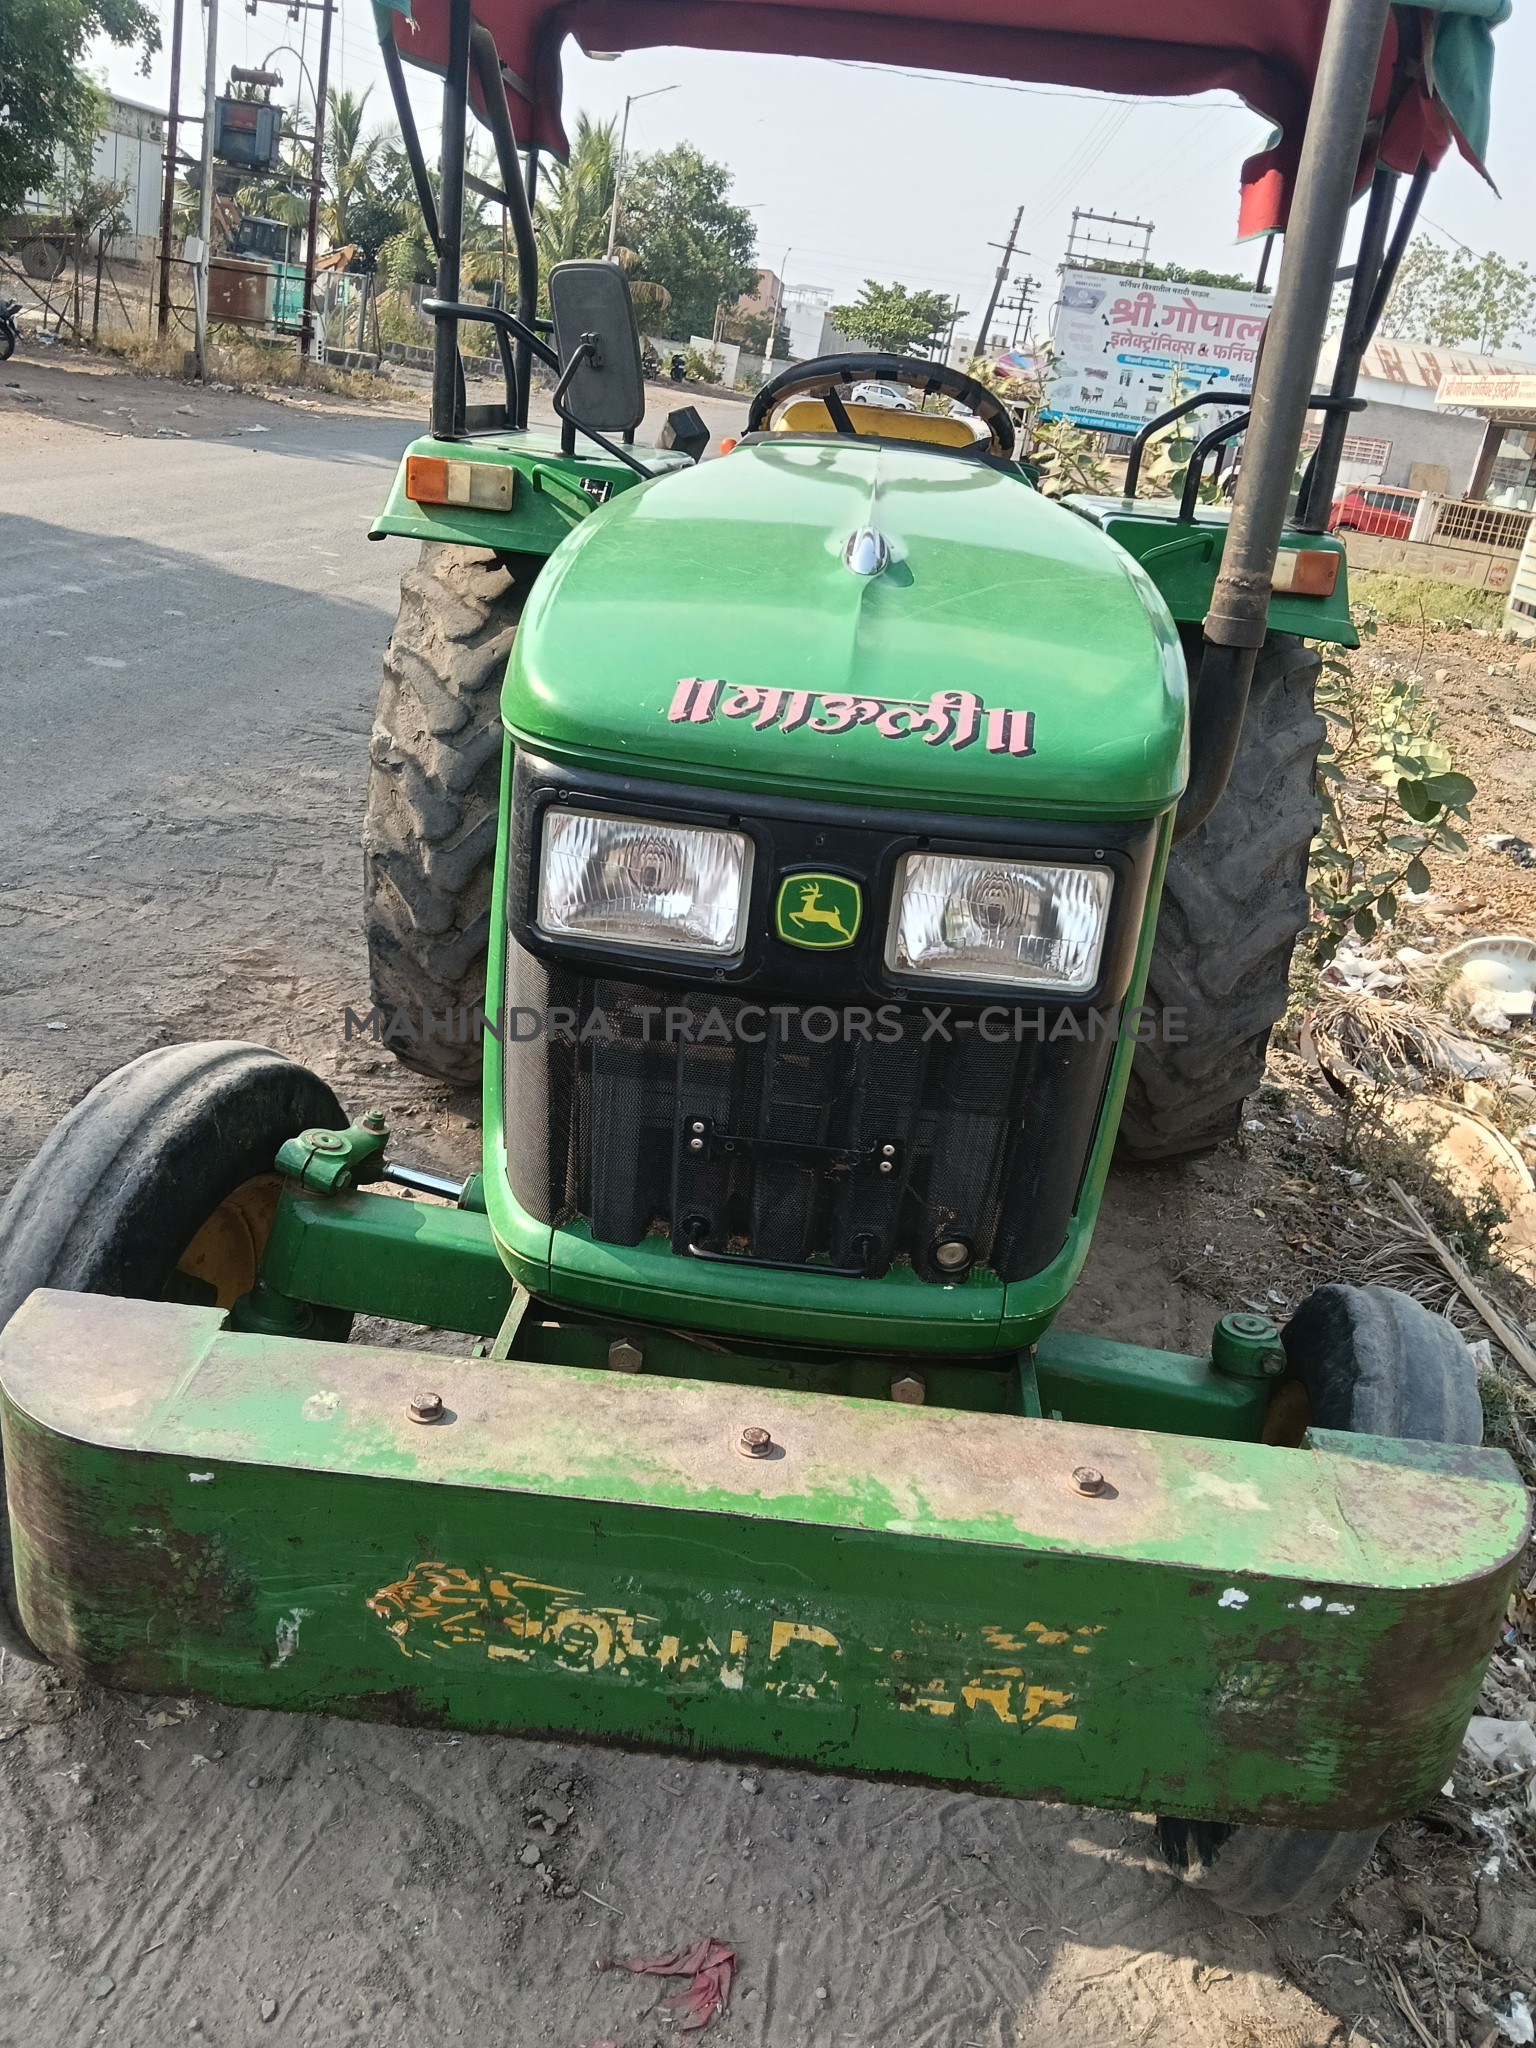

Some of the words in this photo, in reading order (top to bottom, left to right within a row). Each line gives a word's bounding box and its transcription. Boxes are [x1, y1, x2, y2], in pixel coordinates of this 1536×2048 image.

[1109, 292, 1157, 328] श्री
[1161, 297, 1268, 342] गोपाल
[1110, 328, 1197, 356] इलेक्ट्रॉनिक्स
[1197, 342, 1210, 358] &
[1212, 341, 1259, 364] फर्निच
[1471, 375, 1495, 398] फर्निचर
